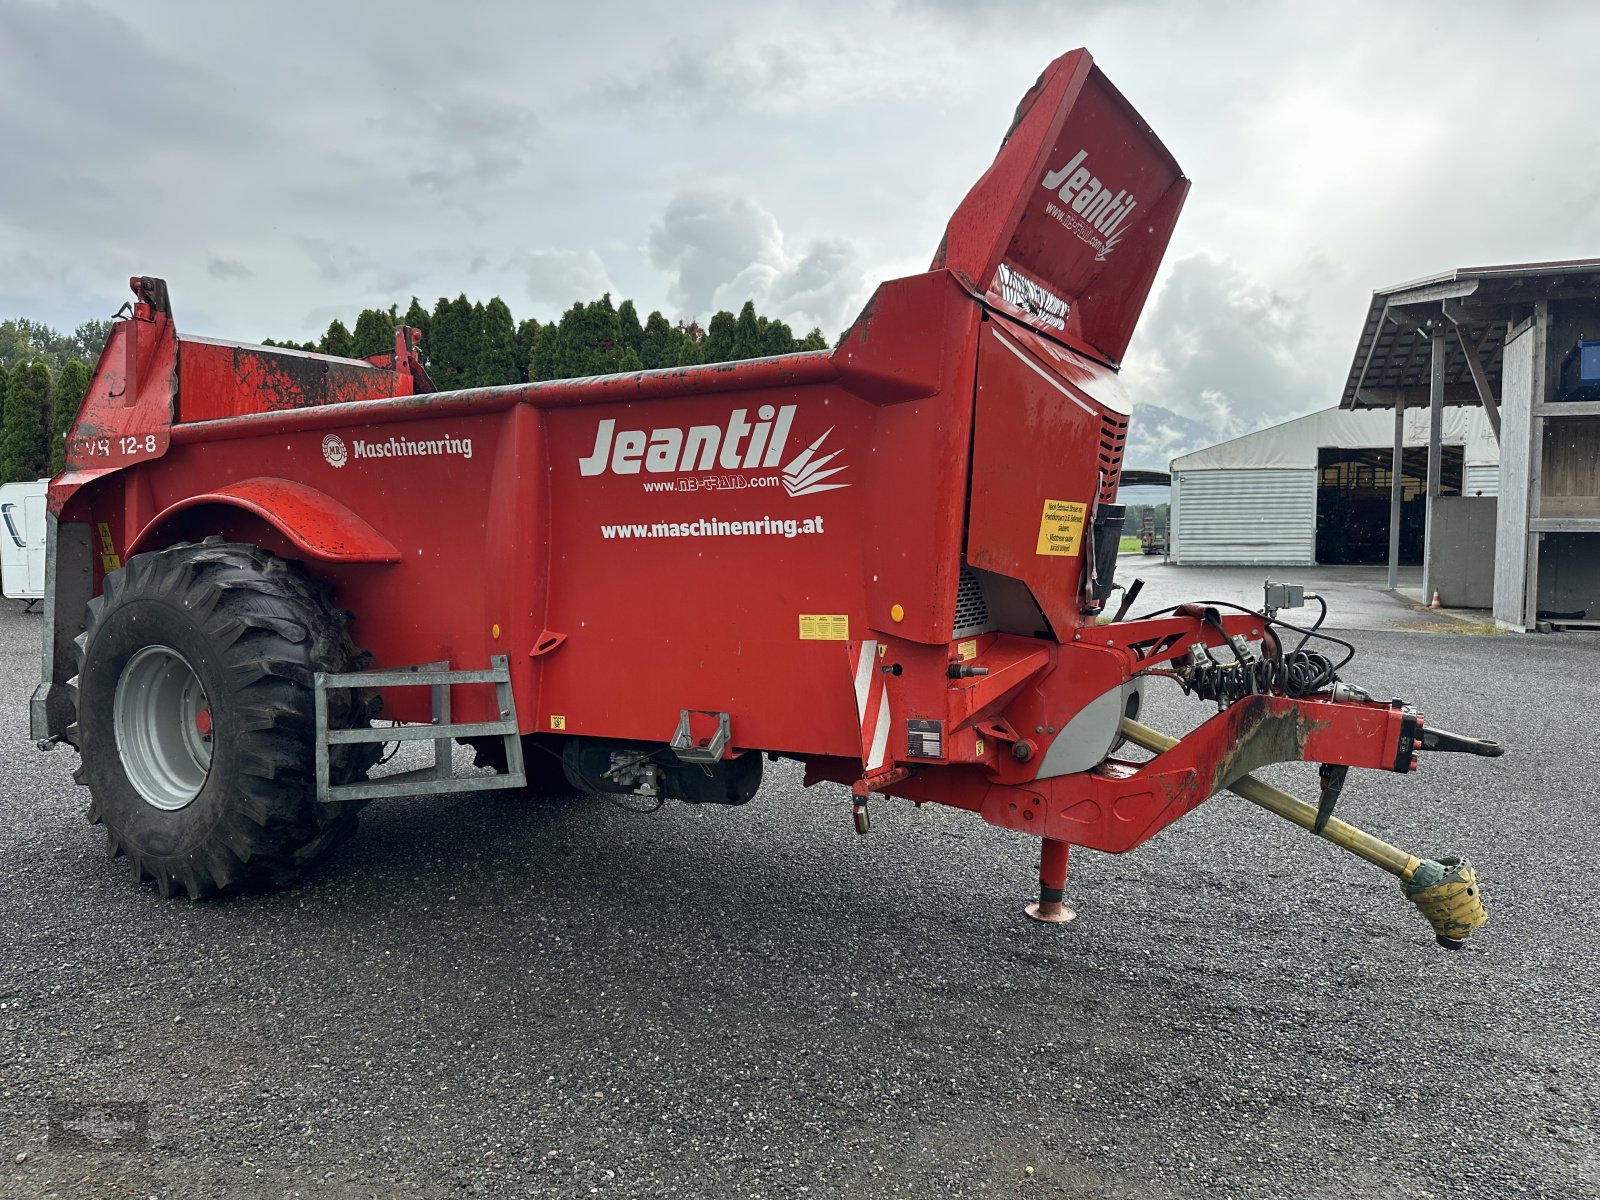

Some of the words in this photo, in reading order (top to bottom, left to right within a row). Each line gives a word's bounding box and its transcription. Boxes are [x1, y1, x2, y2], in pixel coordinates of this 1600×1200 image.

[1041, 149, 1137, 237] Jeantil
[119, 434, 156, 453] 12-8
[329, 445, 341, 456] MR
[353, 433, 473, 459] Maschinenring
[578, 404, 798, 477] Jeantil
[601, 515, 824, 539] www.maschinenring.at
